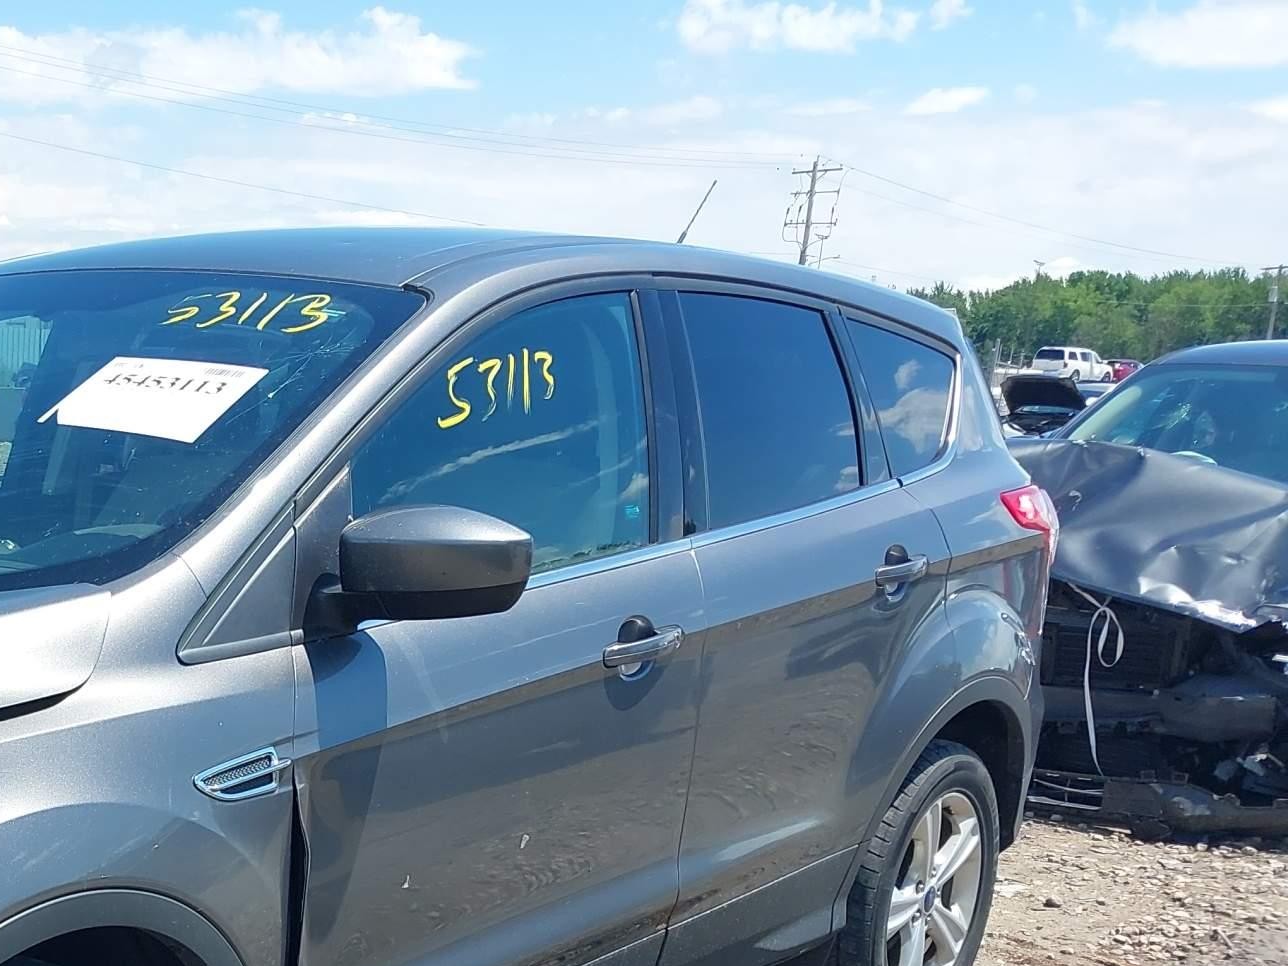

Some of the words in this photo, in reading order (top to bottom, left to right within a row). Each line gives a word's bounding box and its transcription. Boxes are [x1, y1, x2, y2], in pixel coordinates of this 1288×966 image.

[160, 291, 332, 333] 53113
[103, 373, 227, 395] 45453113
[437, 348, 555, 428] 53113
